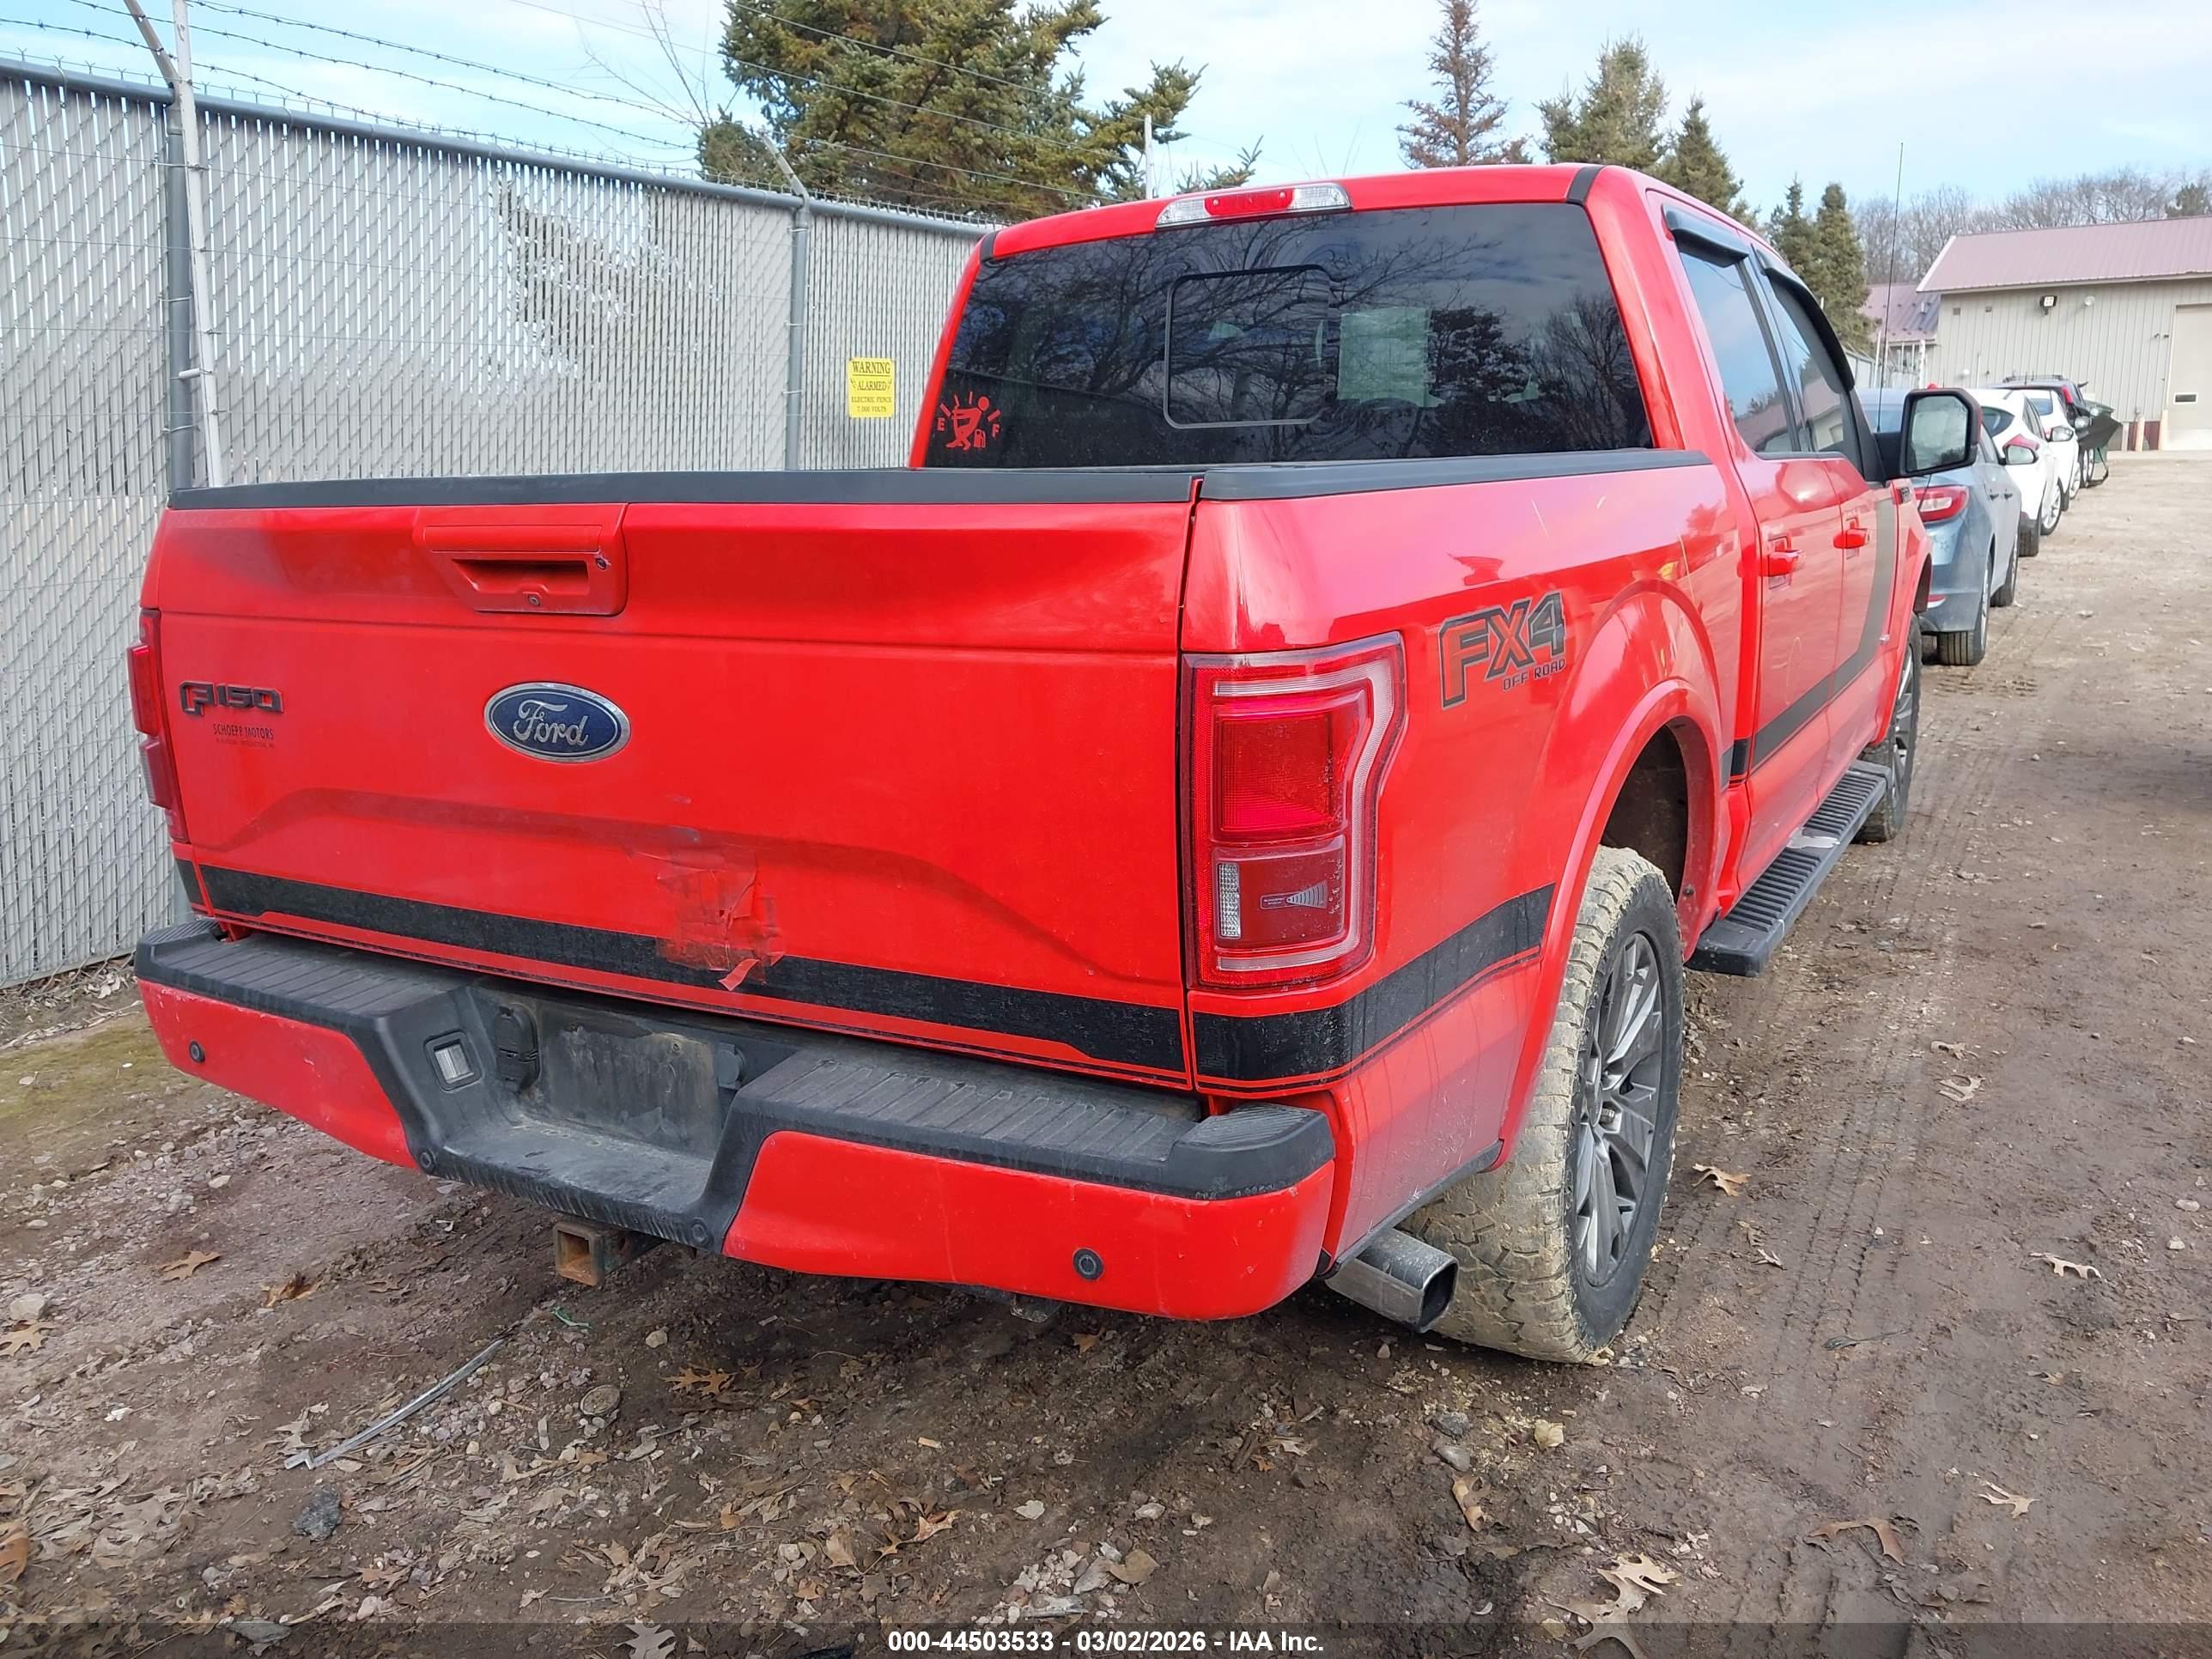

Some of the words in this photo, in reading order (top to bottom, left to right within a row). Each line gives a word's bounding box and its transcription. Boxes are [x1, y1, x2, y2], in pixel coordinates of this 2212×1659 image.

[851, 361, 891, 374] WARNING
[857, 380, 887, 391] ALARMED
[937, 417, 945, 431] E
[992, 423, 1000, 439] F
[1438, 590, 1567, 711] FX4
[1503, 672, 1528, 691] OFF
[1534, 659, 1566, 679] ROAD
[513, 699, 590, 746] Ford
[213, 723, 242, 736] SCHOEPP
[245, 726, 275, 739] MOTORS
